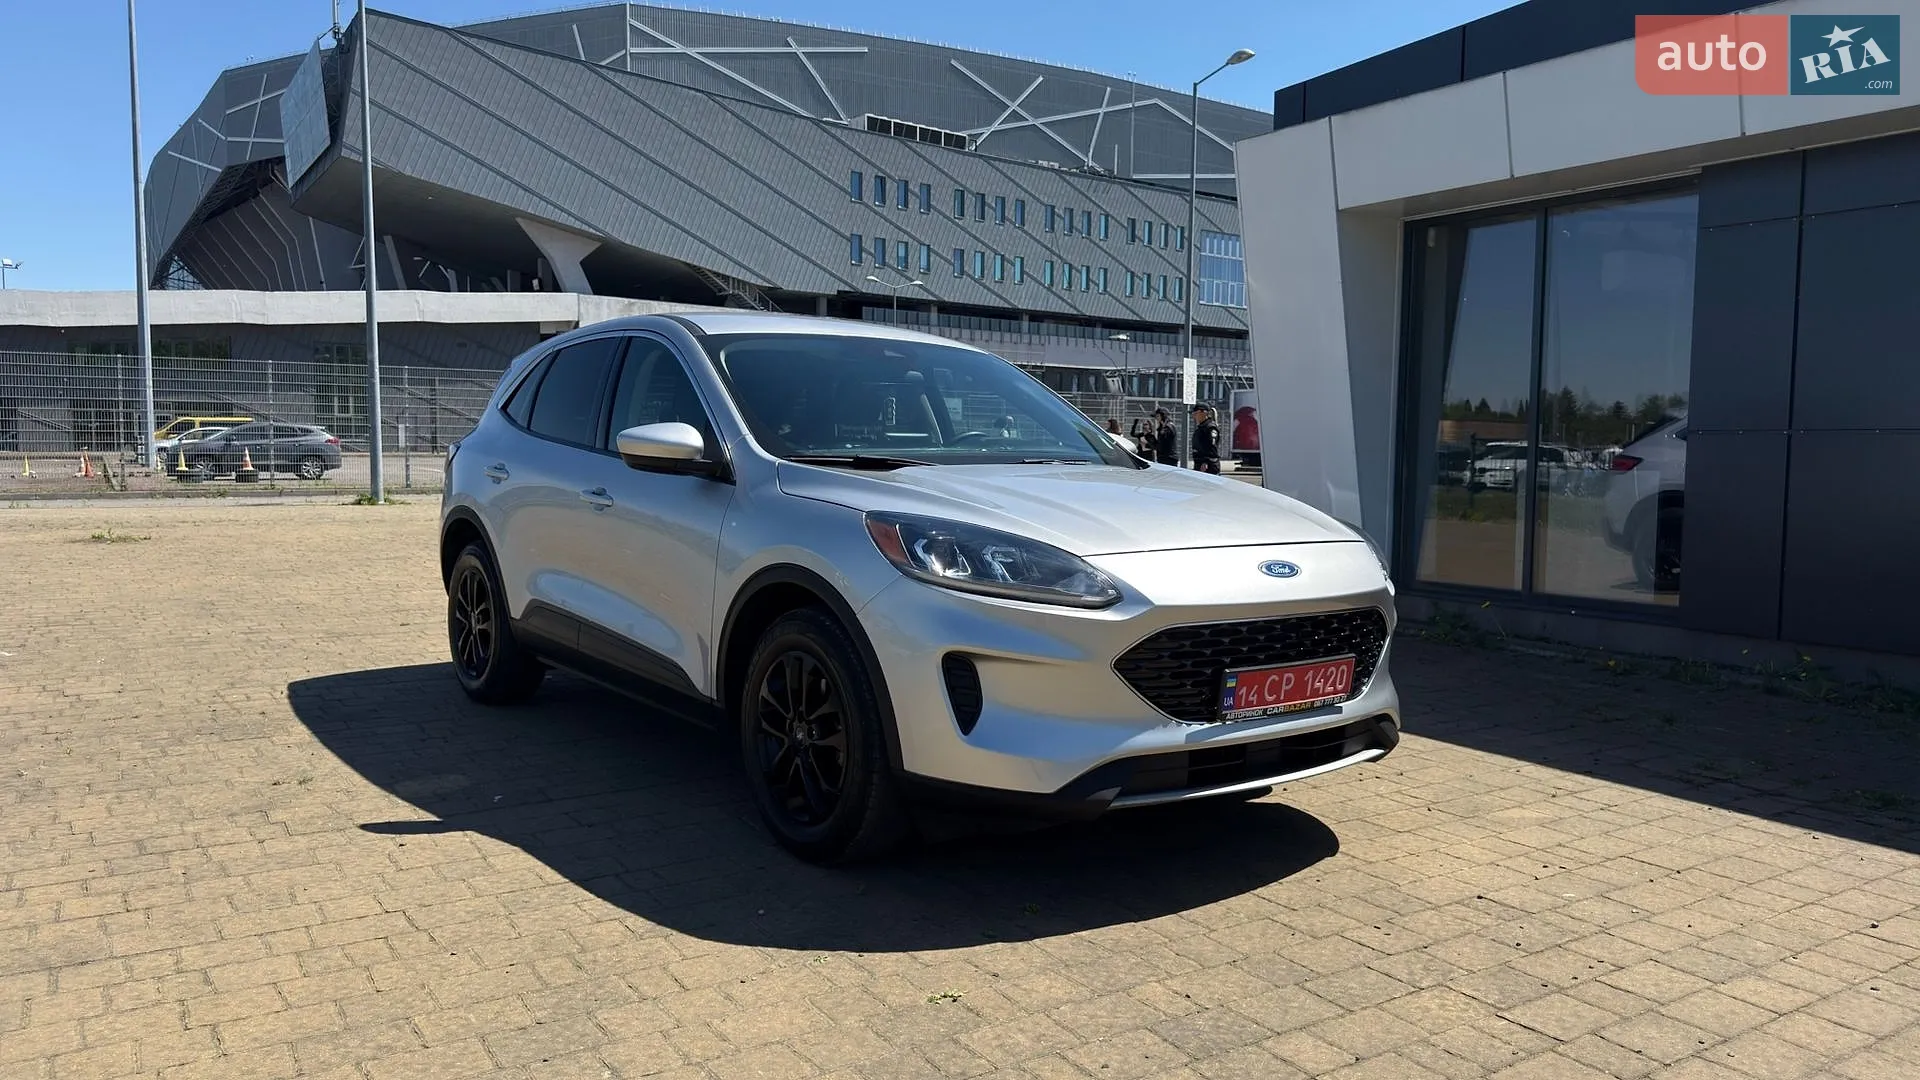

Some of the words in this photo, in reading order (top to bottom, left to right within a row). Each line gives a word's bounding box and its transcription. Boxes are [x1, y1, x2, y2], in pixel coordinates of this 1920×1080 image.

[1270, 564, 1291, 574] Ford
[1238, 684, 1260, 707] 14
[1264, 673, 1295, 701] CP
[1304, 665, 1348, 697] 1420
[1223, 696, 1234, 707] UA
[1266, 702, 1312, 715] CARBAZAR
